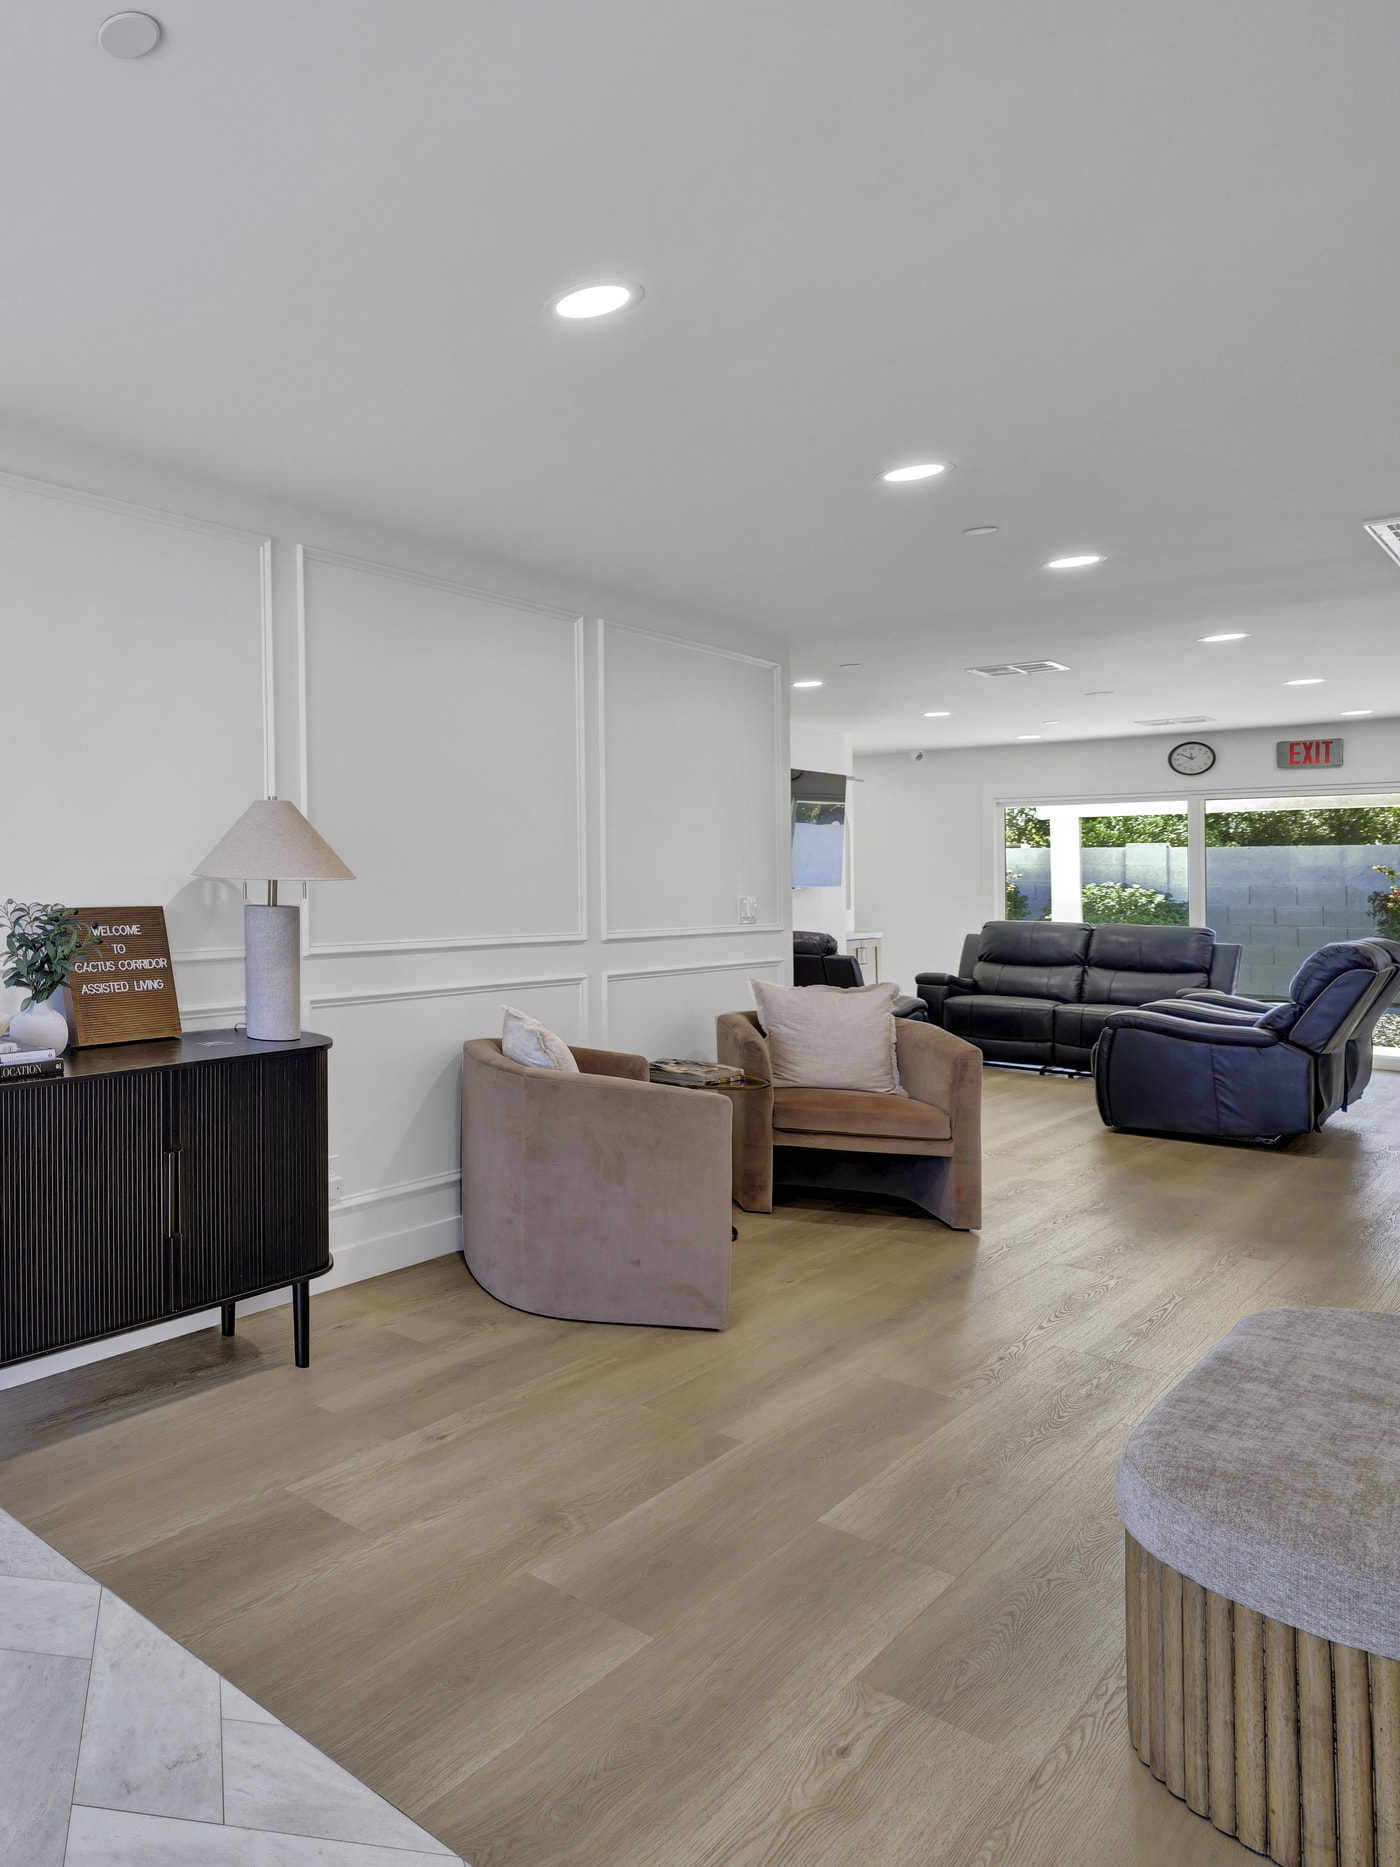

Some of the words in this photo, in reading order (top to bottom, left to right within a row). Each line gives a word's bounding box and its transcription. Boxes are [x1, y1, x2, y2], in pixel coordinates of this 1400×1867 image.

[1289, 741, 1334, 765] EXIT
[91, 924, 142, 937] WELCOME
[111, 943, 126, 954] TO
[74, 961, 115, 973] CACTUS
[118, 957, 168, 970] CORRIDOR
[81, 981, 129, 995] ASSISTED
[134, 979, 164, 991] LIVING
